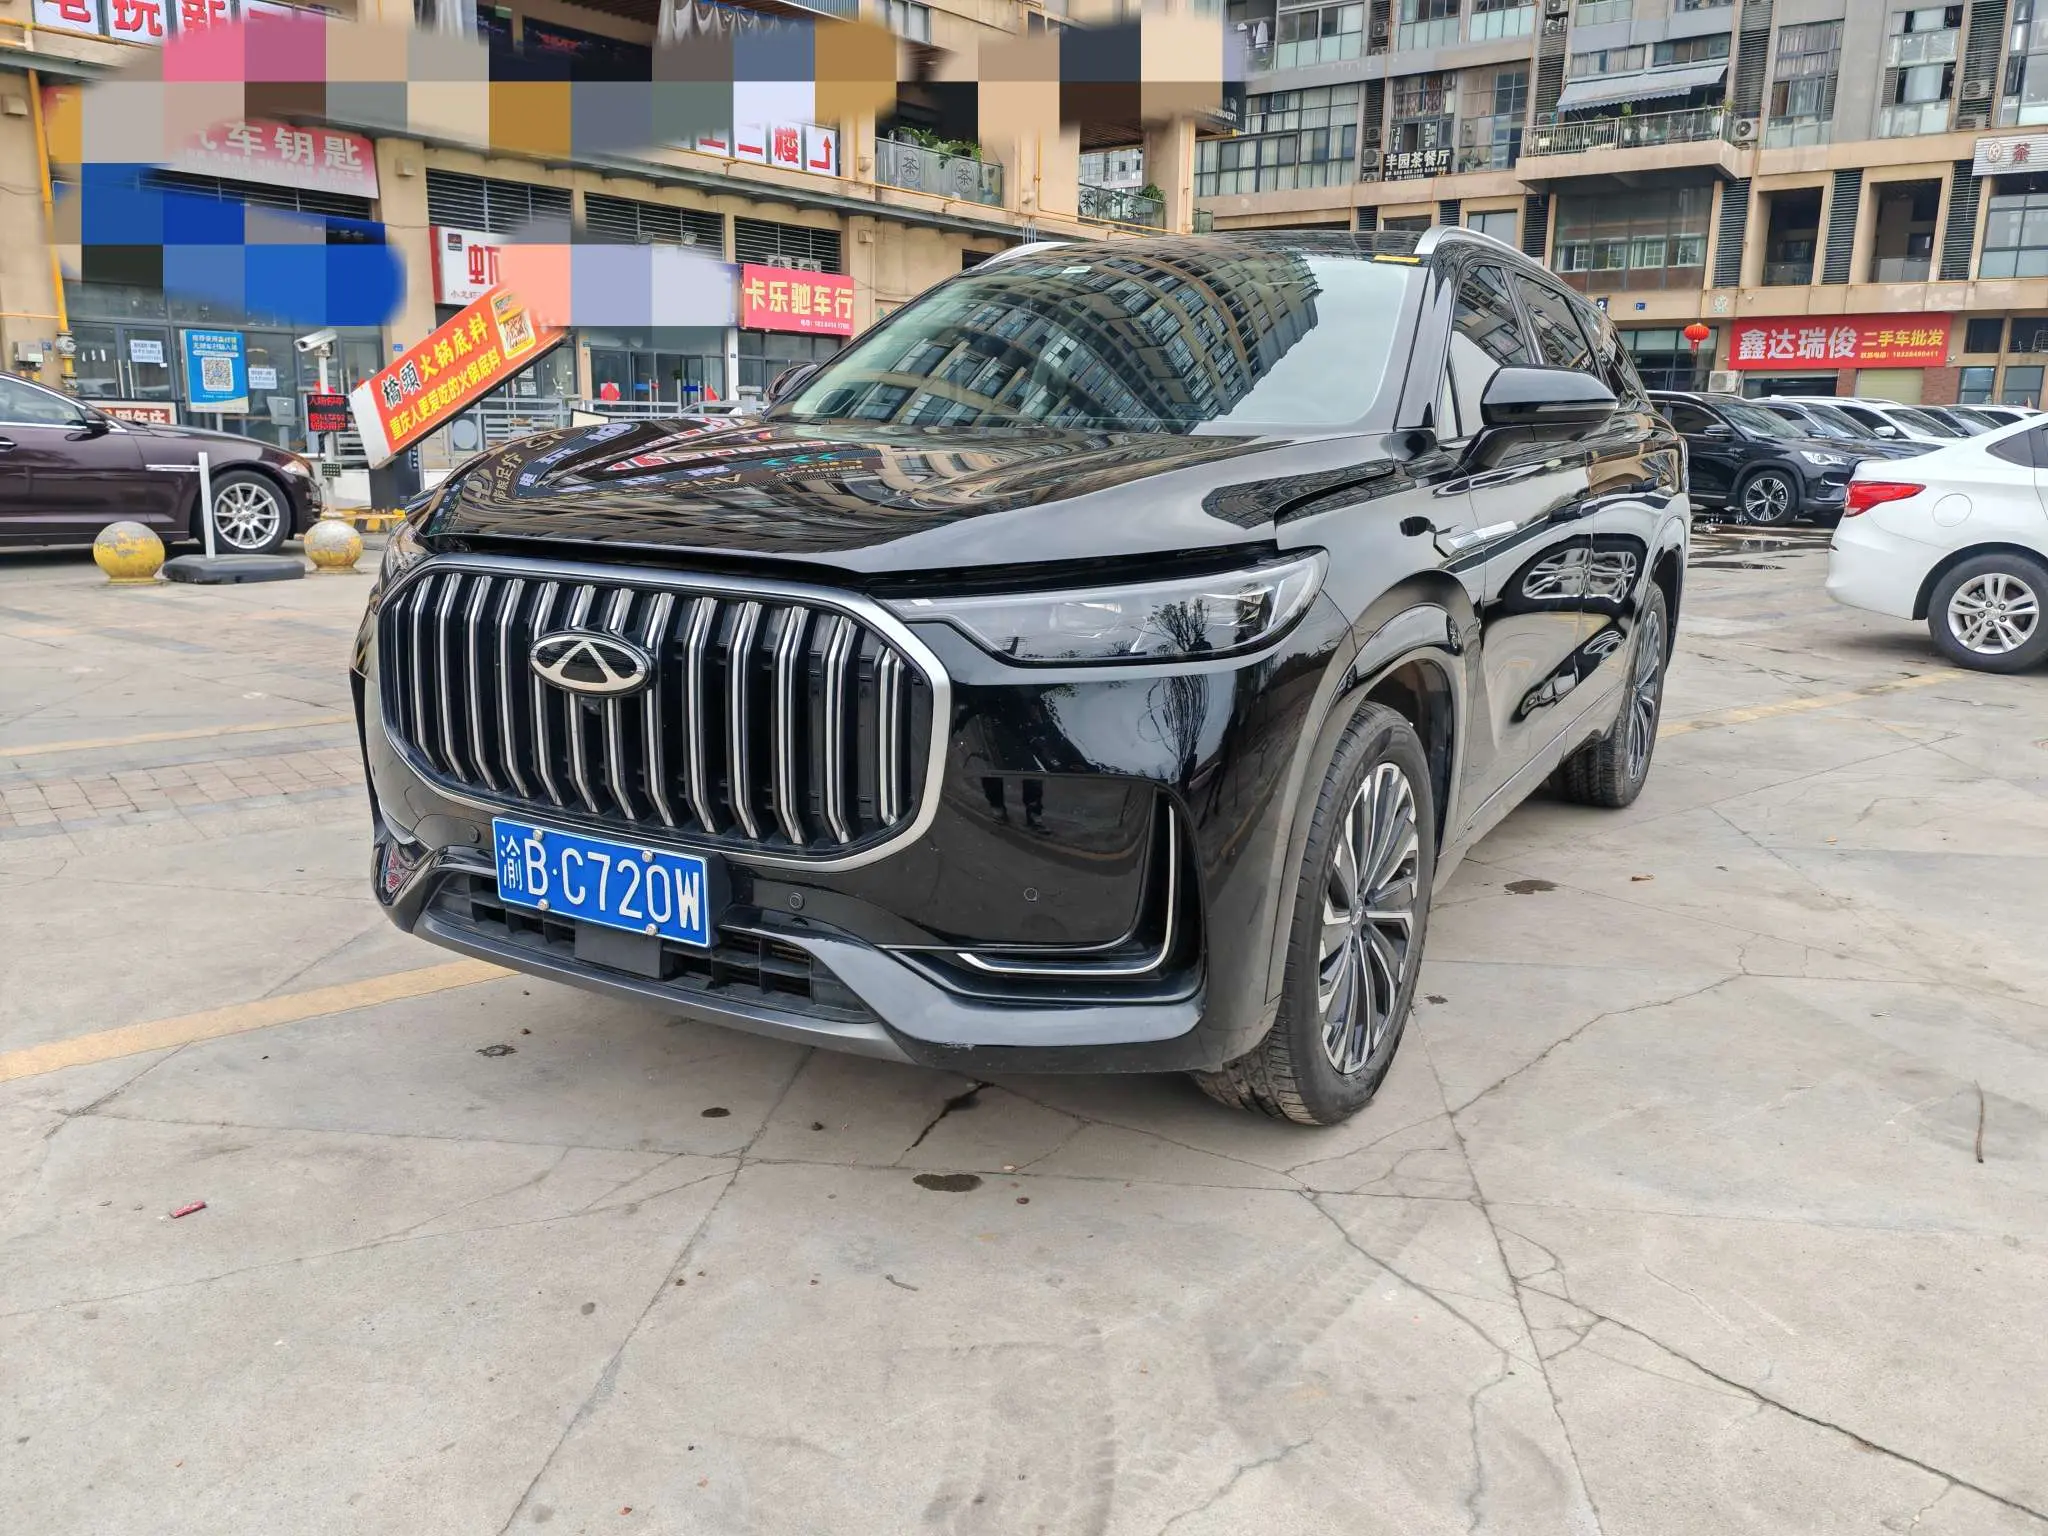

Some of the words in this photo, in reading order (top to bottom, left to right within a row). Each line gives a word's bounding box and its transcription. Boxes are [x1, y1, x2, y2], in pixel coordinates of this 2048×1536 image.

[901, 157, 919, 176] 茶
[1385, 150, 1451, 171] 半园茶餐厅
[957, 168, 973, 186] 茶
[744, 277, 853, 320] 卡乐驰车行
[1738, 326, 1858, 361] 鑫达瑞俊
[1861, 329, 1945, 348] 二手车批发
[388, 345, 502, 441] 重庆人更爱吃的火锅底料
